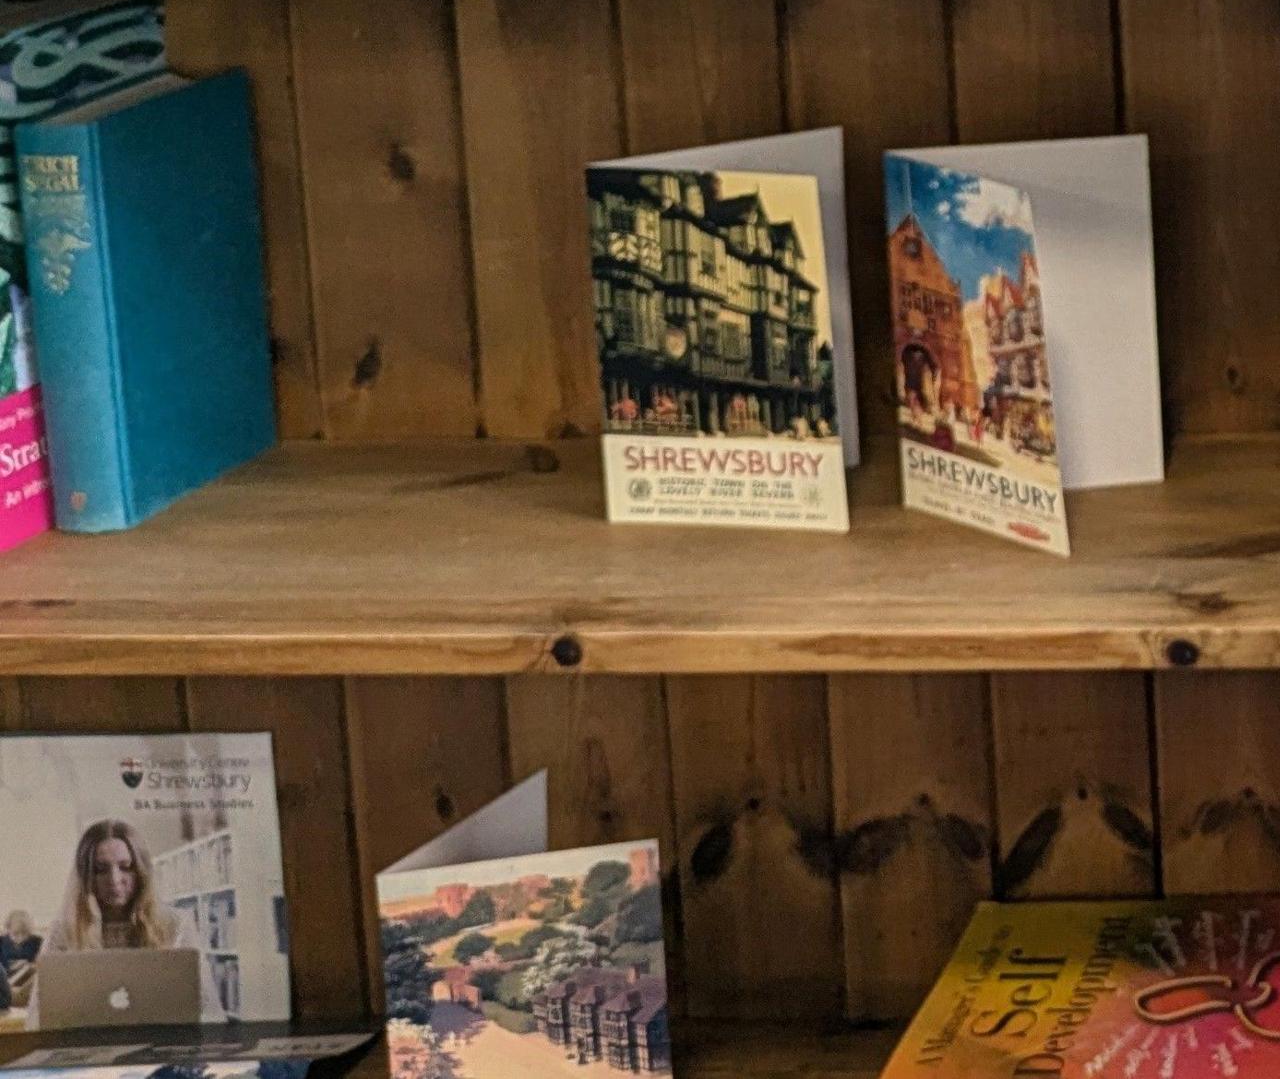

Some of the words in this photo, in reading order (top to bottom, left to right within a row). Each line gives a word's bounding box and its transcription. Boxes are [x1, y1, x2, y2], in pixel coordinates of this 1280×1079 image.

[623, 445, 824, 477] SHREWSBURY
[907, 447, 1057, 514] SHREWSBURY
[147, 771, 252, 793] Shrewsbury
[969, 947, 1068, 1040] Self
